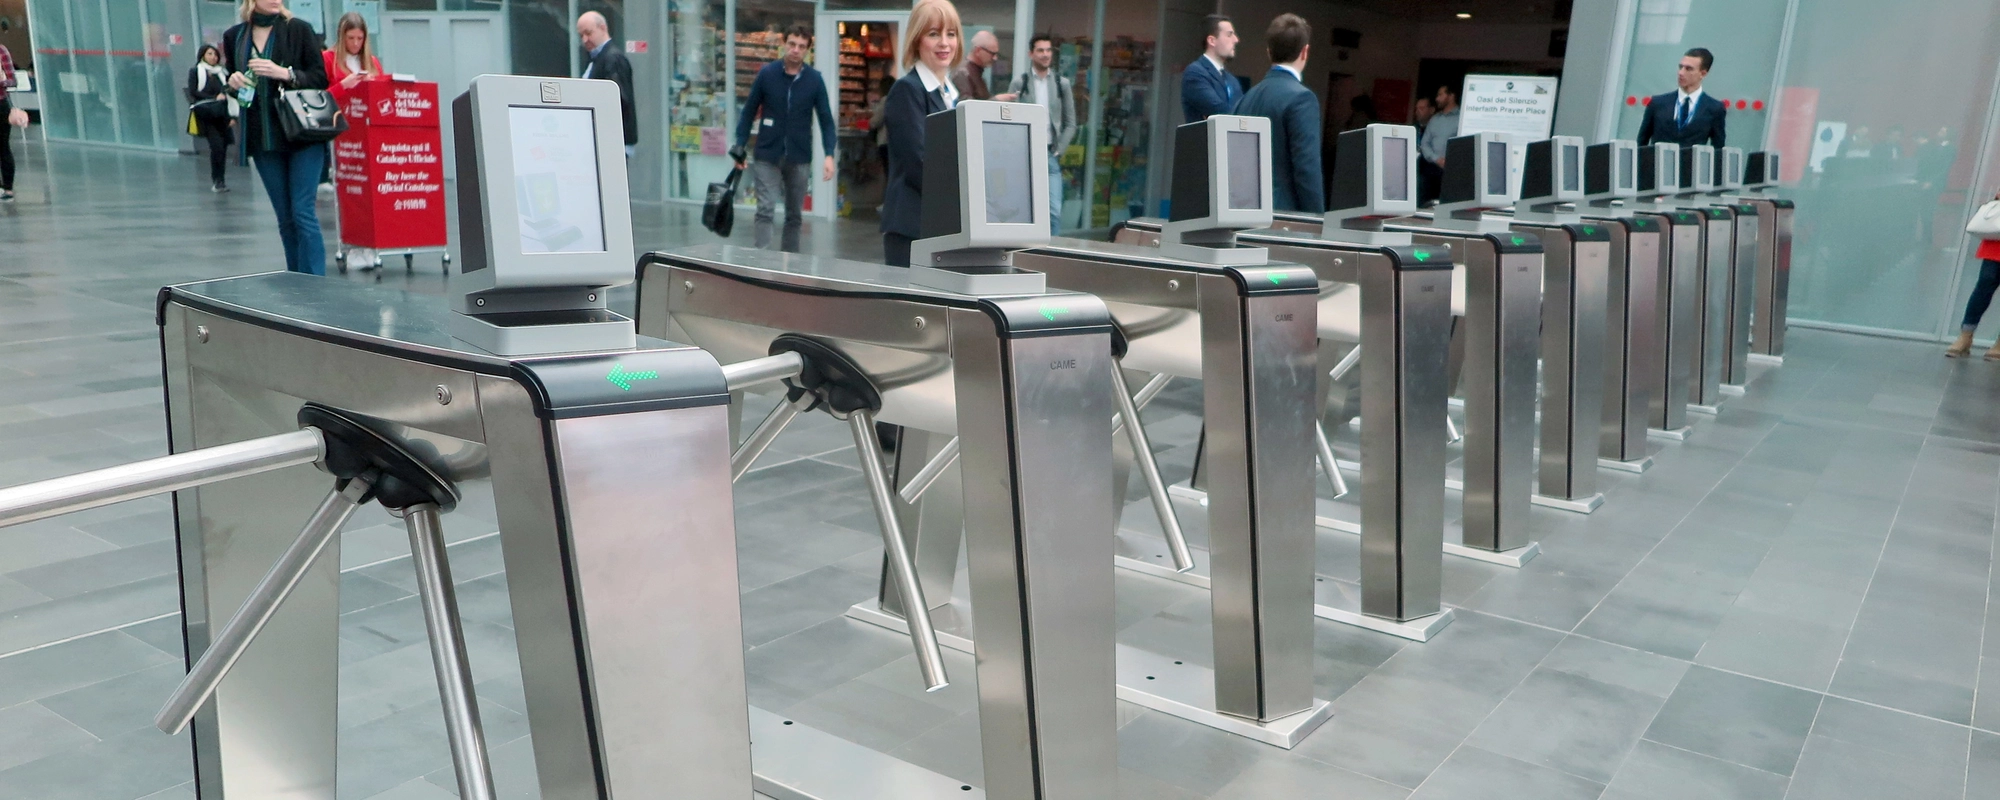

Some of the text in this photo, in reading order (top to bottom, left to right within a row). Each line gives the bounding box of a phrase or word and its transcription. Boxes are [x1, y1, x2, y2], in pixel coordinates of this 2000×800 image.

[394, 89, 419, 98] Salone
[407, 99, 432, 109] Mobile
[1476, 95, 1538, 105] Oasi del Silenzio
[395, 108, 421, 117] Milano
[1465, 105, 1547, 115] Interfaith Prayer Place
[380, 142, 430, 154] Acquista qui il
[376, 155, 437, 165] Catalogo Ufficiale
[385, 171, 429, 182] Buy here the
[377, 183, 440, 194] Official Catalogue
[1275, 313, 1293, 322] CAME
[1050, 359, 1076, 370] CAME
